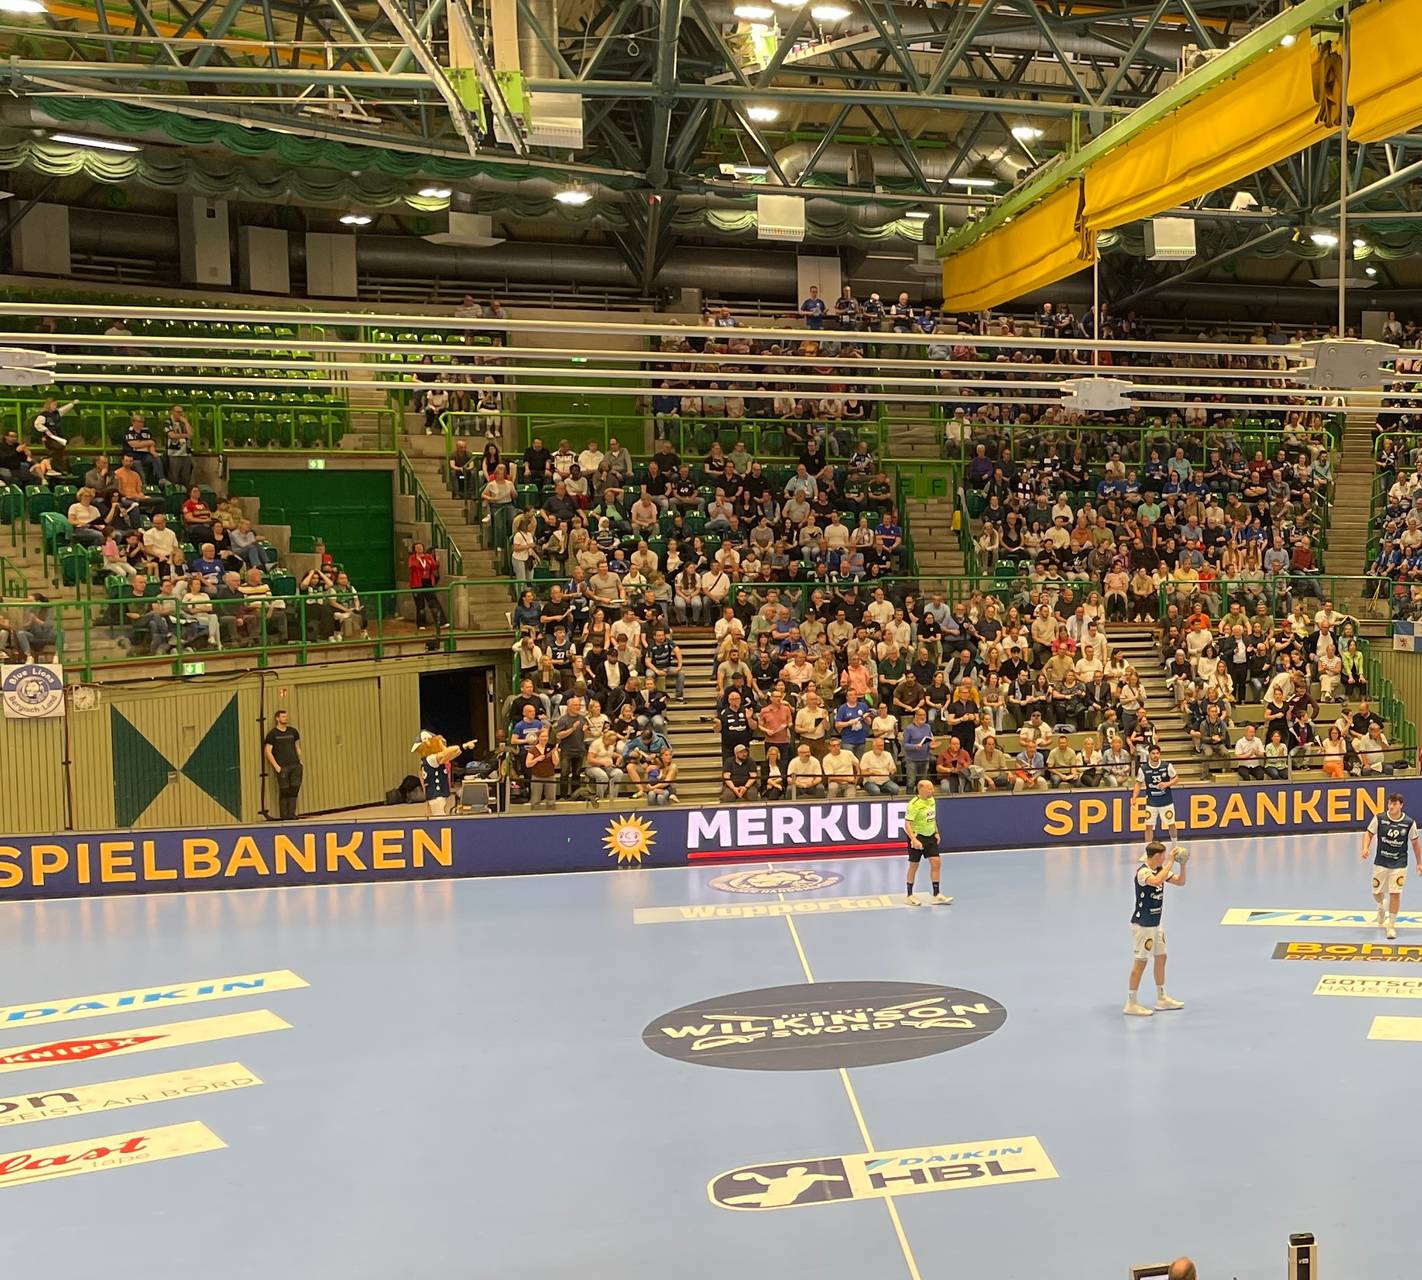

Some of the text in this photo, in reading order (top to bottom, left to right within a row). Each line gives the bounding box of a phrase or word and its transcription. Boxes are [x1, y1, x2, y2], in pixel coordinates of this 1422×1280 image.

[9, 667, 55, 685] Blue Lions
[680, 894, 893, 918] Wuppertal
[6, 978, 265, 1022] DAIKIN
[661, 1003, 991, 1040] WILKINSON
[772, 1020, 896, 1039] SWORD
[4, 1036, 138, 1065] KNIPEX
[103, 1093, 151, 1108] AN
[160, 1077, 255, 1098] BORD
[92, 1152, 151, 1168] tape
[897, 1146, 1023, 1166] DAIKIN
[868, 1159, 1037, 1190] HBL
